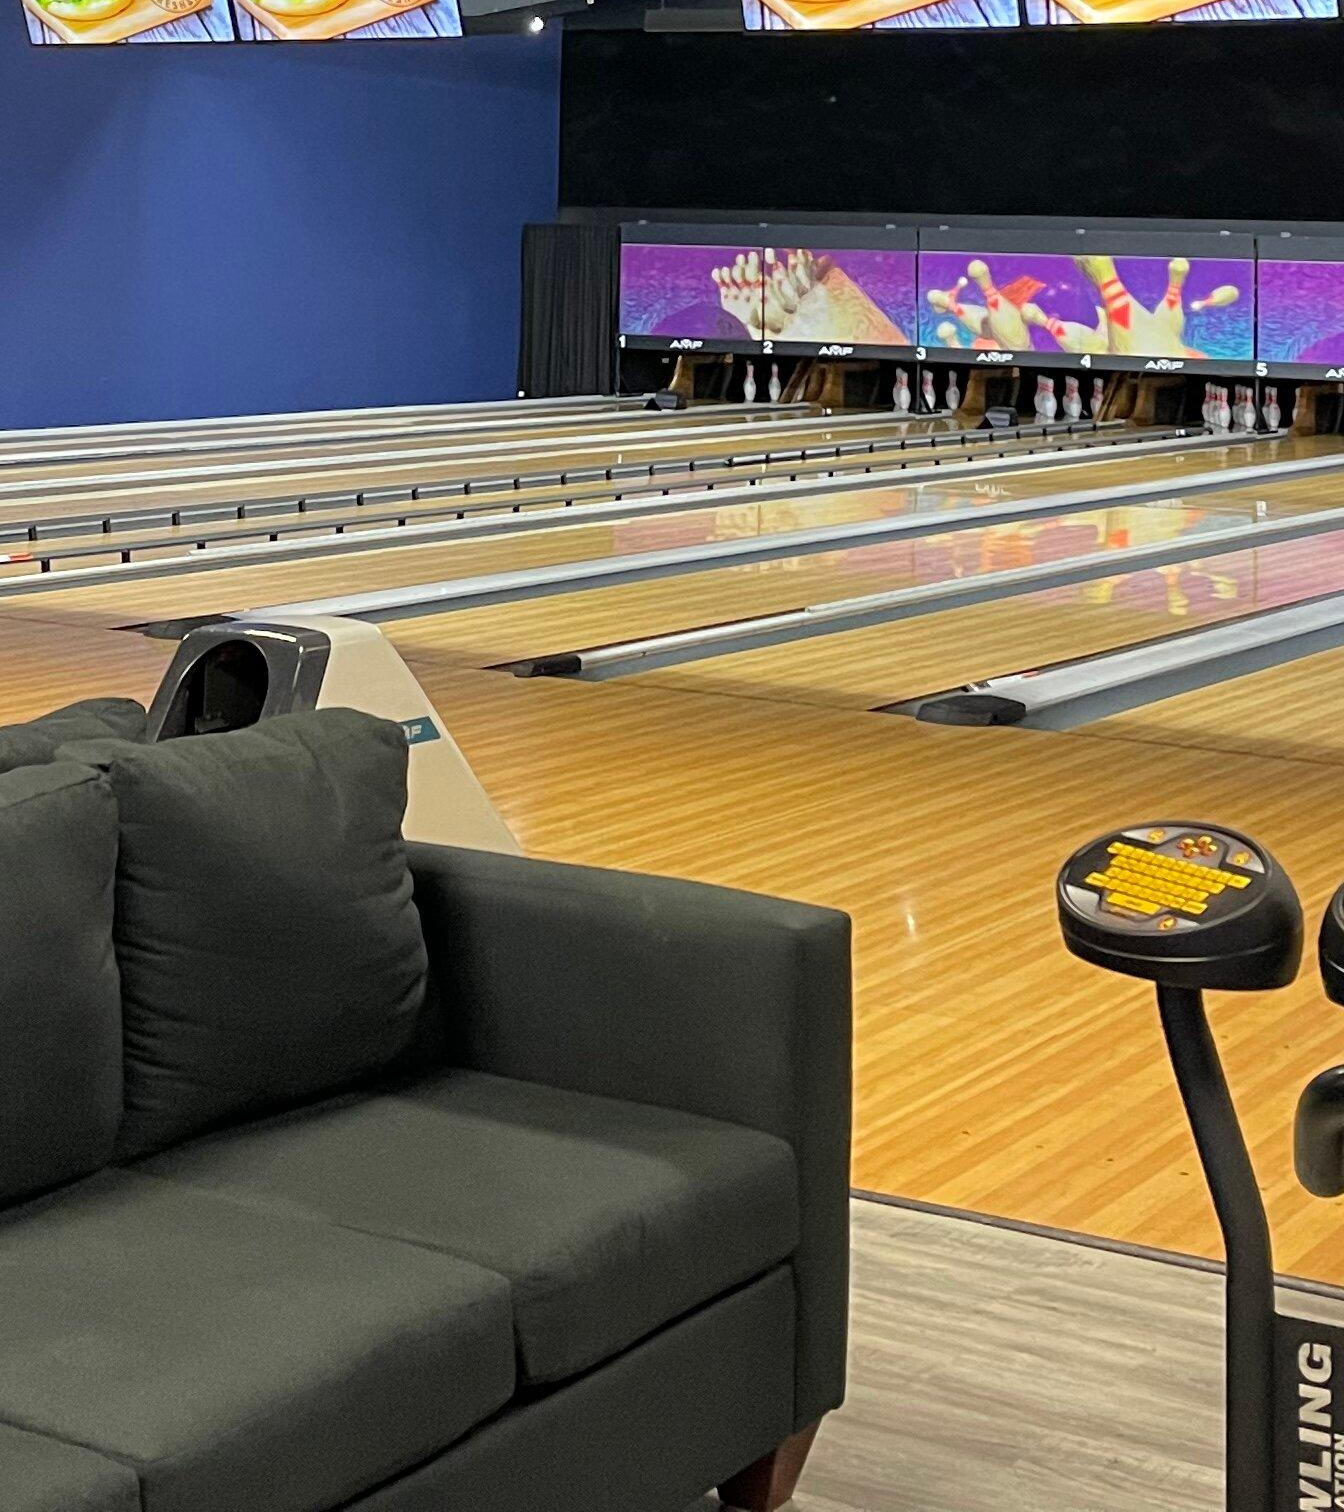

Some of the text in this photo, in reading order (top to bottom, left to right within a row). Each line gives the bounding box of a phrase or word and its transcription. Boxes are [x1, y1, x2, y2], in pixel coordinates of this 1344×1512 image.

[618, 334, 626, 348] 1
[762, 340, 773, 355] 2
[916, 347, 927, 360] 3
[1080, 354, 1091, 368] 4
[1144, 359, 1184, 370] AMF
[1256, 362, 1268, 377] 5
